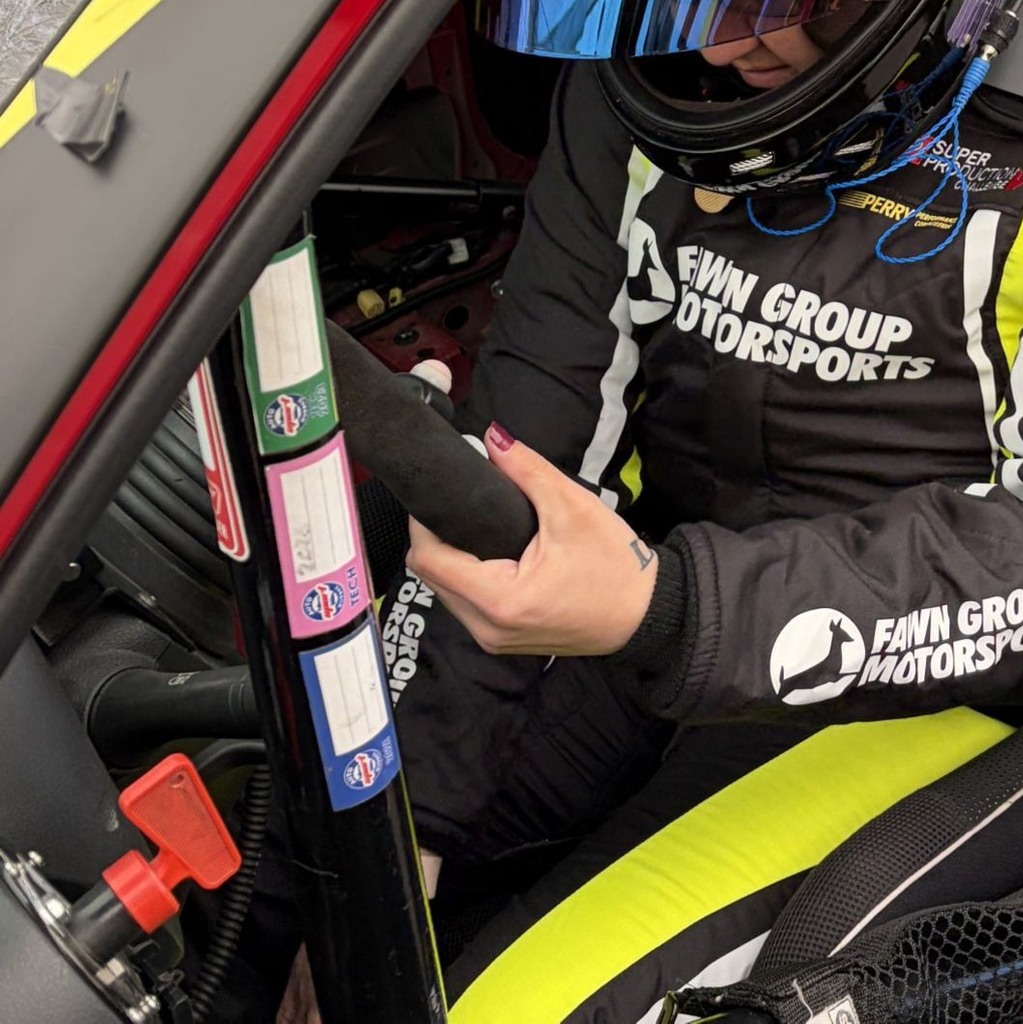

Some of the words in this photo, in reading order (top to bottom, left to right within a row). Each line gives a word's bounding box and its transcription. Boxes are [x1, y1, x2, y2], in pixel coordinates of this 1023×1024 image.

[932, 139, 993, 167] SUPER
[953, 179, 1010, 193] CALLENGE
[862, 193, 916, 222] PERRY
[672, 284, 936, 383] OTORSPORTS
[761, 282, 913, 353] GROUP
[347, 566, 360, 607] TECH
[870, 604, 950, 655] FAWN
